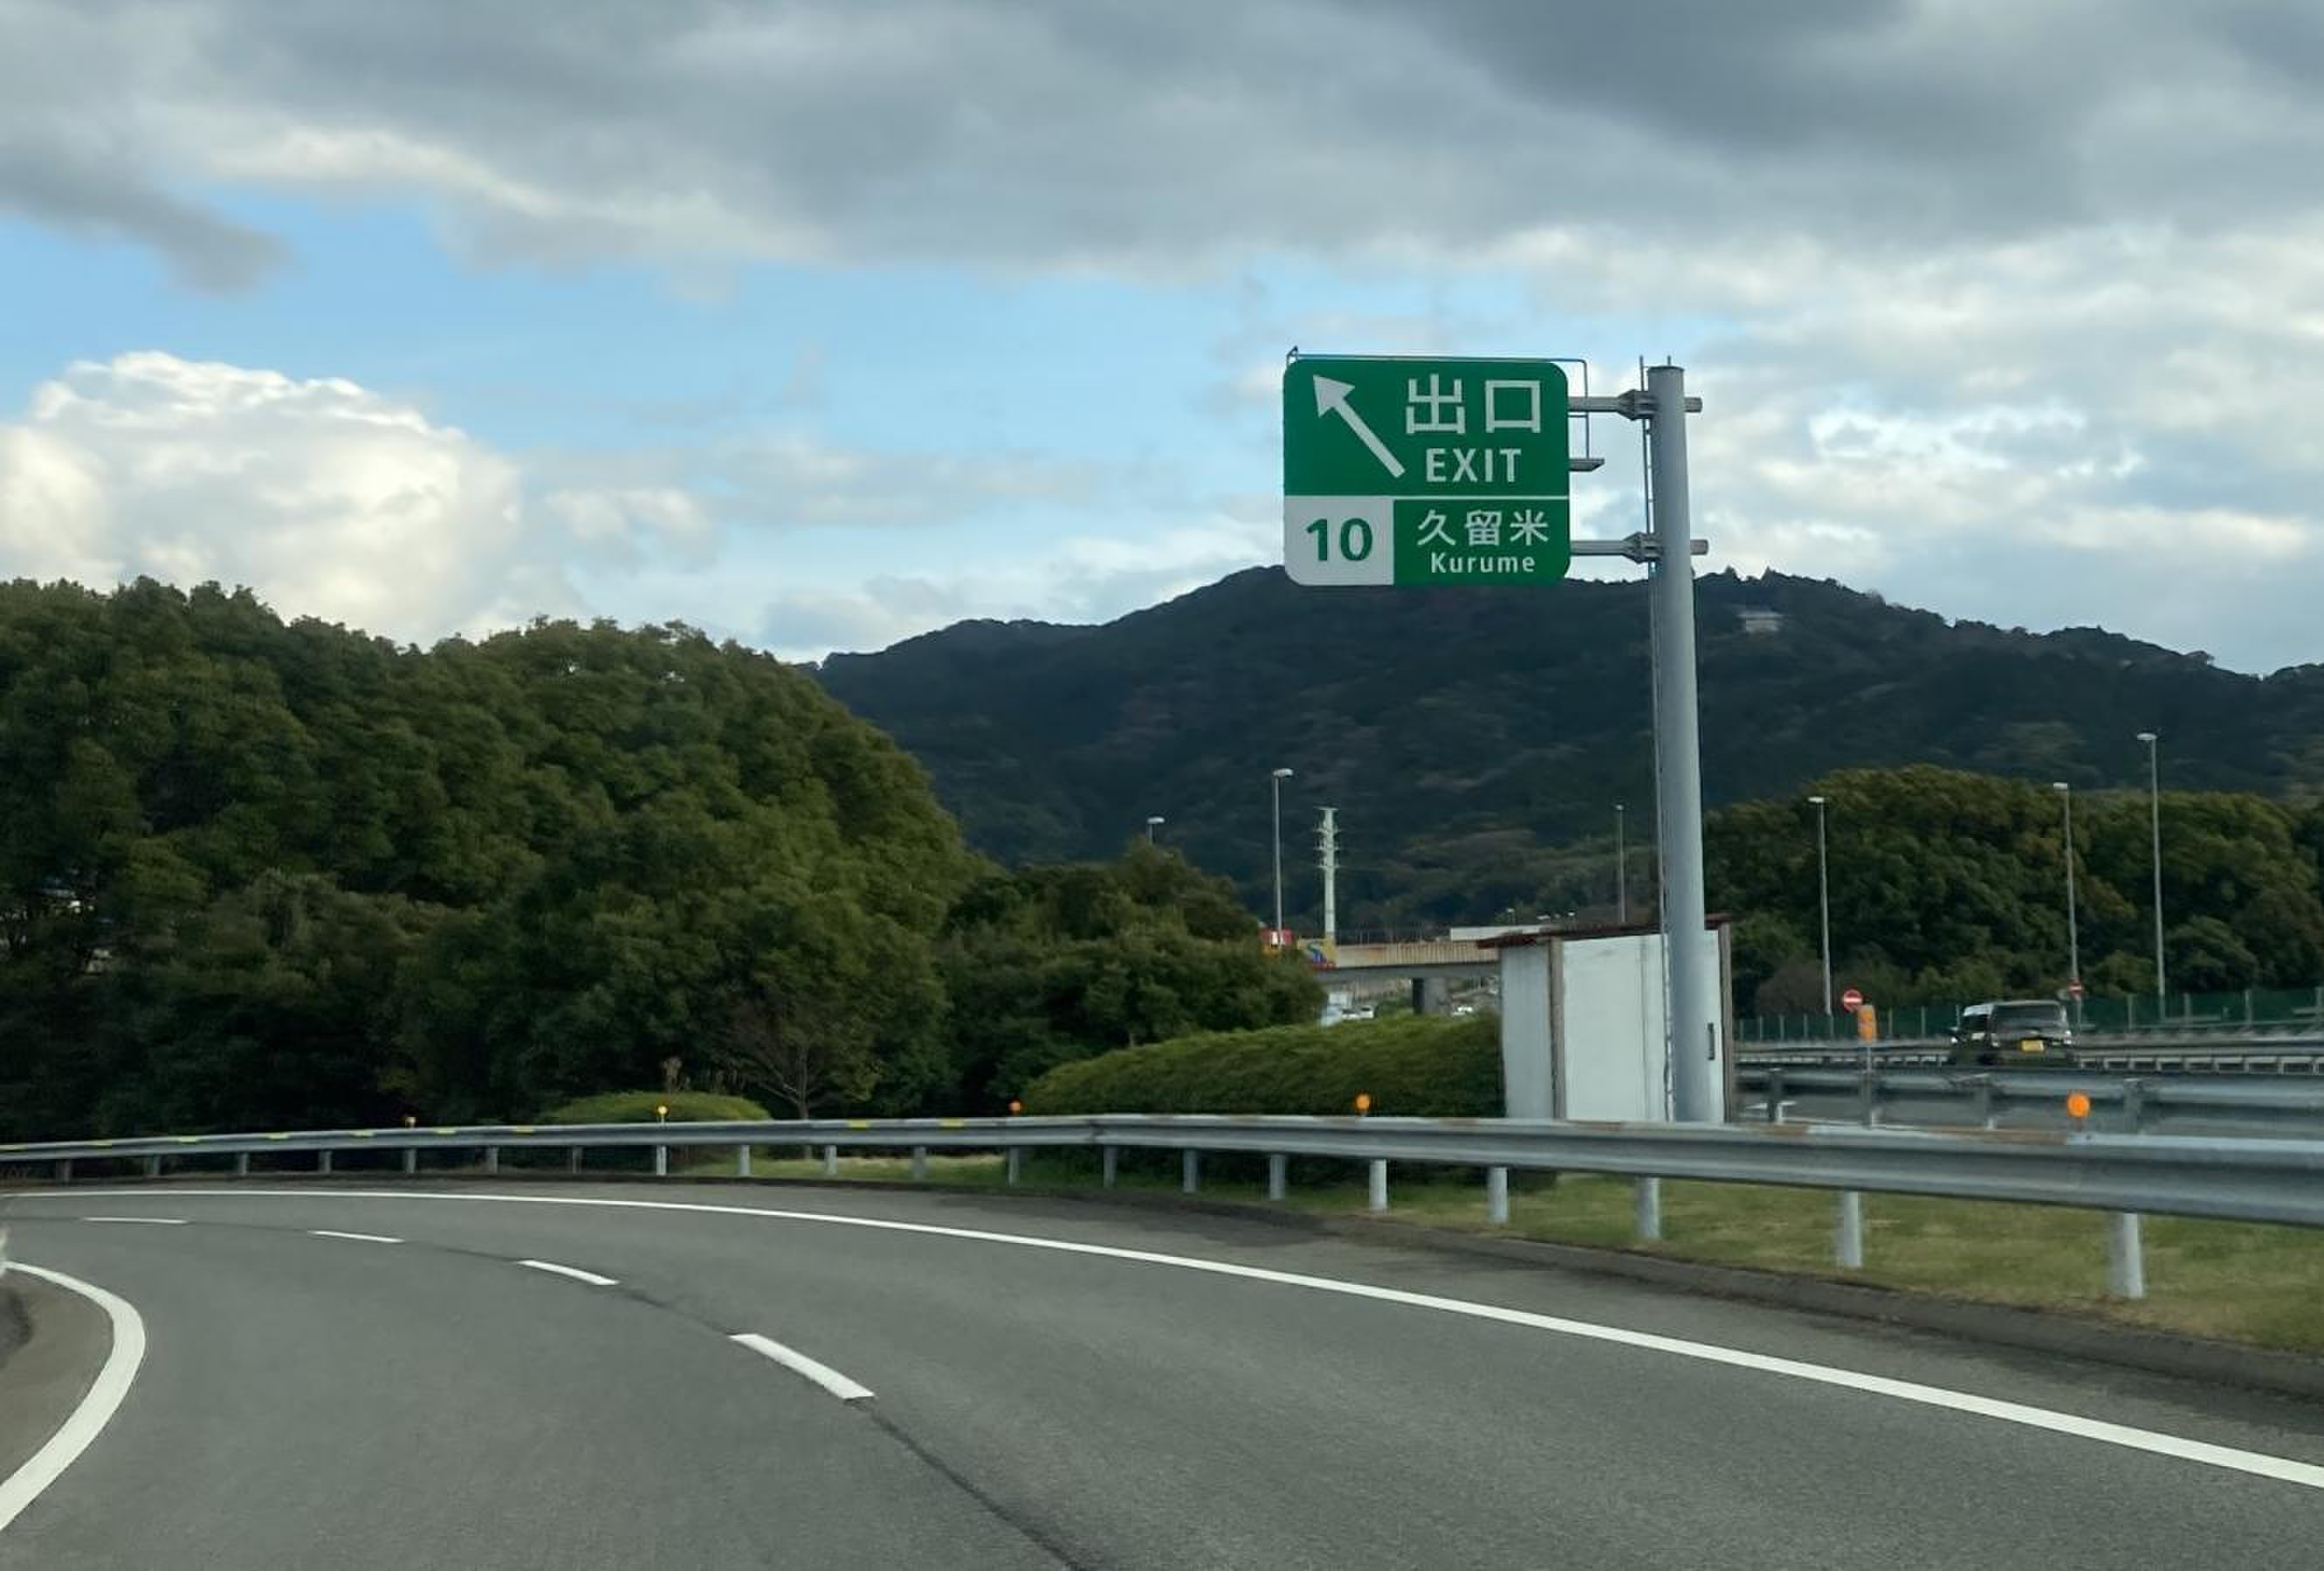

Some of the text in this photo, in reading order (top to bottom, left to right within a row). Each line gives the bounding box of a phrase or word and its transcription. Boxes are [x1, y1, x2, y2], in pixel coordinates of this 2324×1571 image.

[1405, 373, 1542, 435] 出口
[1425, 448, 1522, 483] EXIT
[1305, 518, 1373, 561] 10
[1416, 509, 1550, 546] 久留米
[1430, 552, 1537, 573] Kurume
